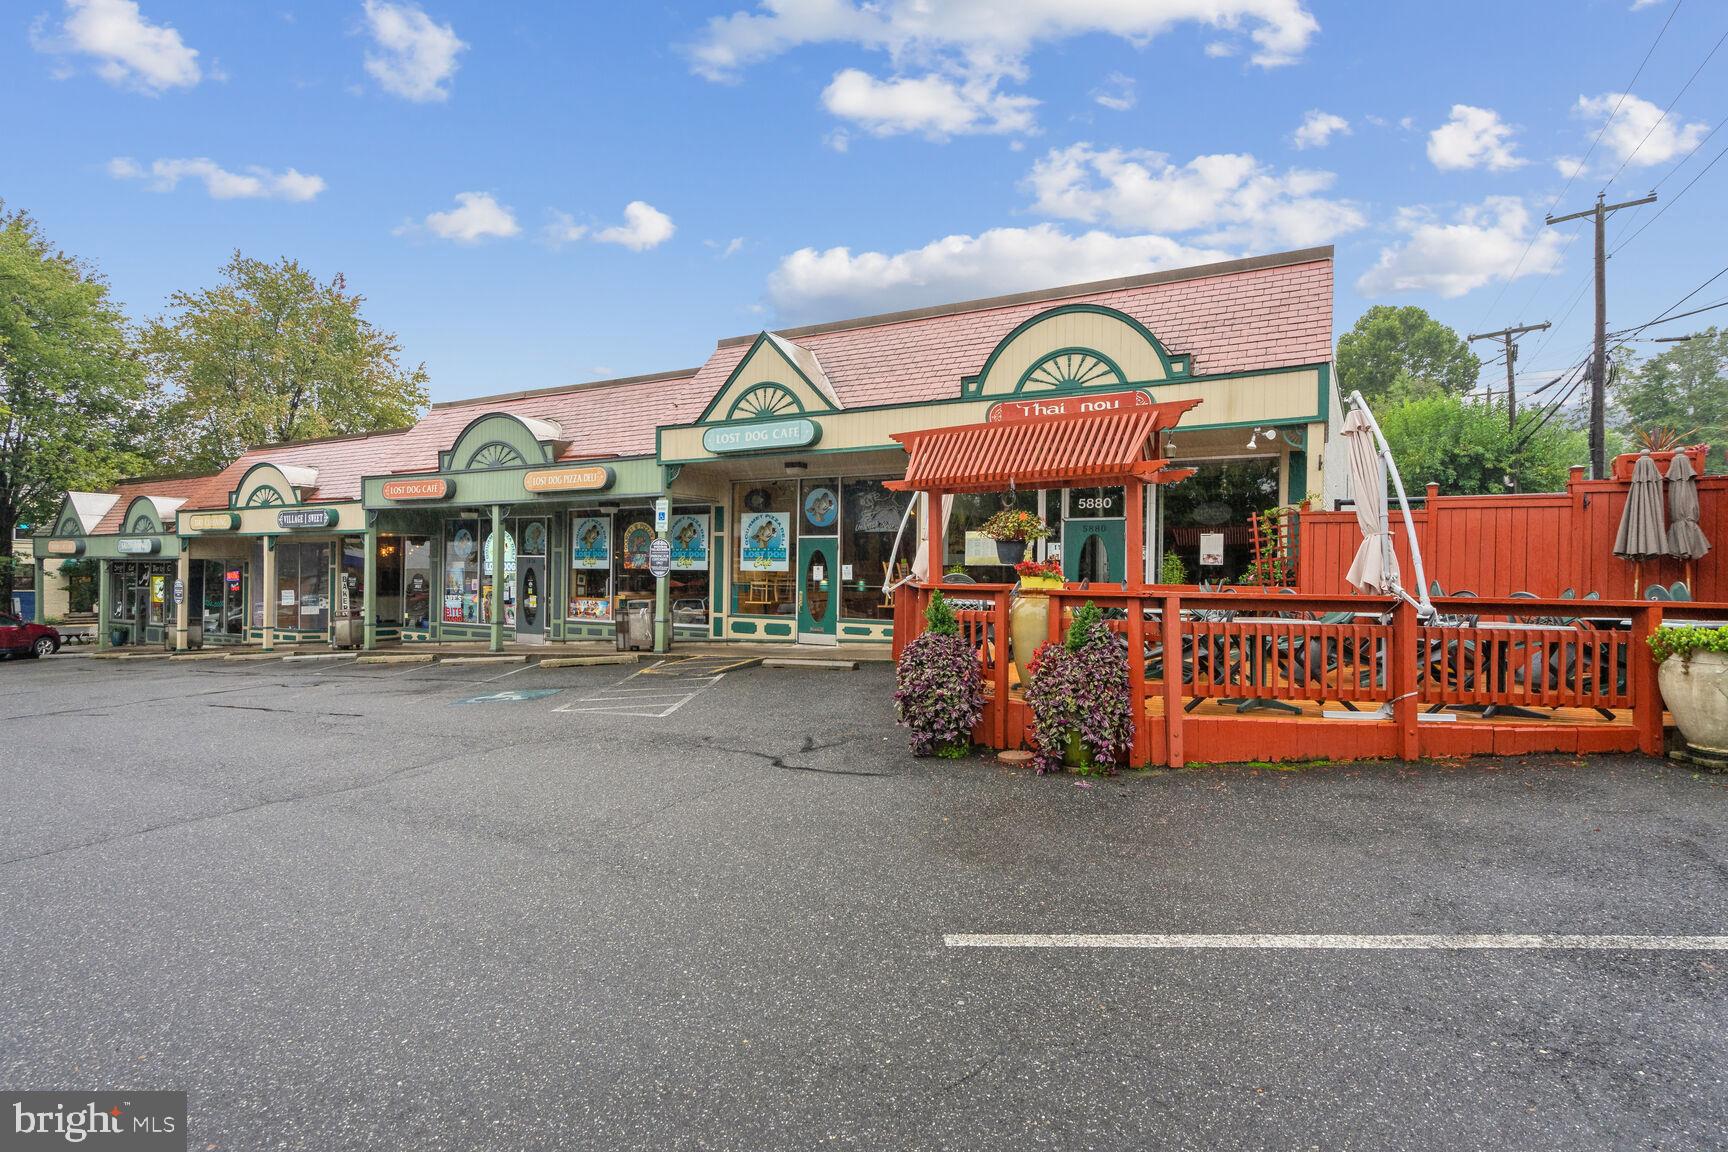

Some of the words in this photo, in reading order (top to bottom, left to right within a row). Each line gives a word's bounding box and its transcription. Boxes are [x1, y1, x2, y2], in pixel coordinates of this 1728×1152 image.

[1017, 402, 1065, 417] Thai
[1080, 400, 1119, 413] nou
[716, 432, 741, 444] LOST
[745, 430, 769, 442] DOG
[772, 426, 800, 439] CAFE
[532, 476, 547, 486] LOST
[548, 475, 563, 485] DOG
[563, 473, 582, 484] PIZZA
[583, 472, 597, 482] DELI
[390, 486, 405, 495] LOST
[406, 485, 421, 494] DOG
[1078, 497, 1112, 509] 5880
[283, 514, 304, 524] VILLAGE
[307, 513, 324, 523] SWEET
[765, 513, 782, 528] PIZZA
[1082, 524, 1106, 533] 5880
